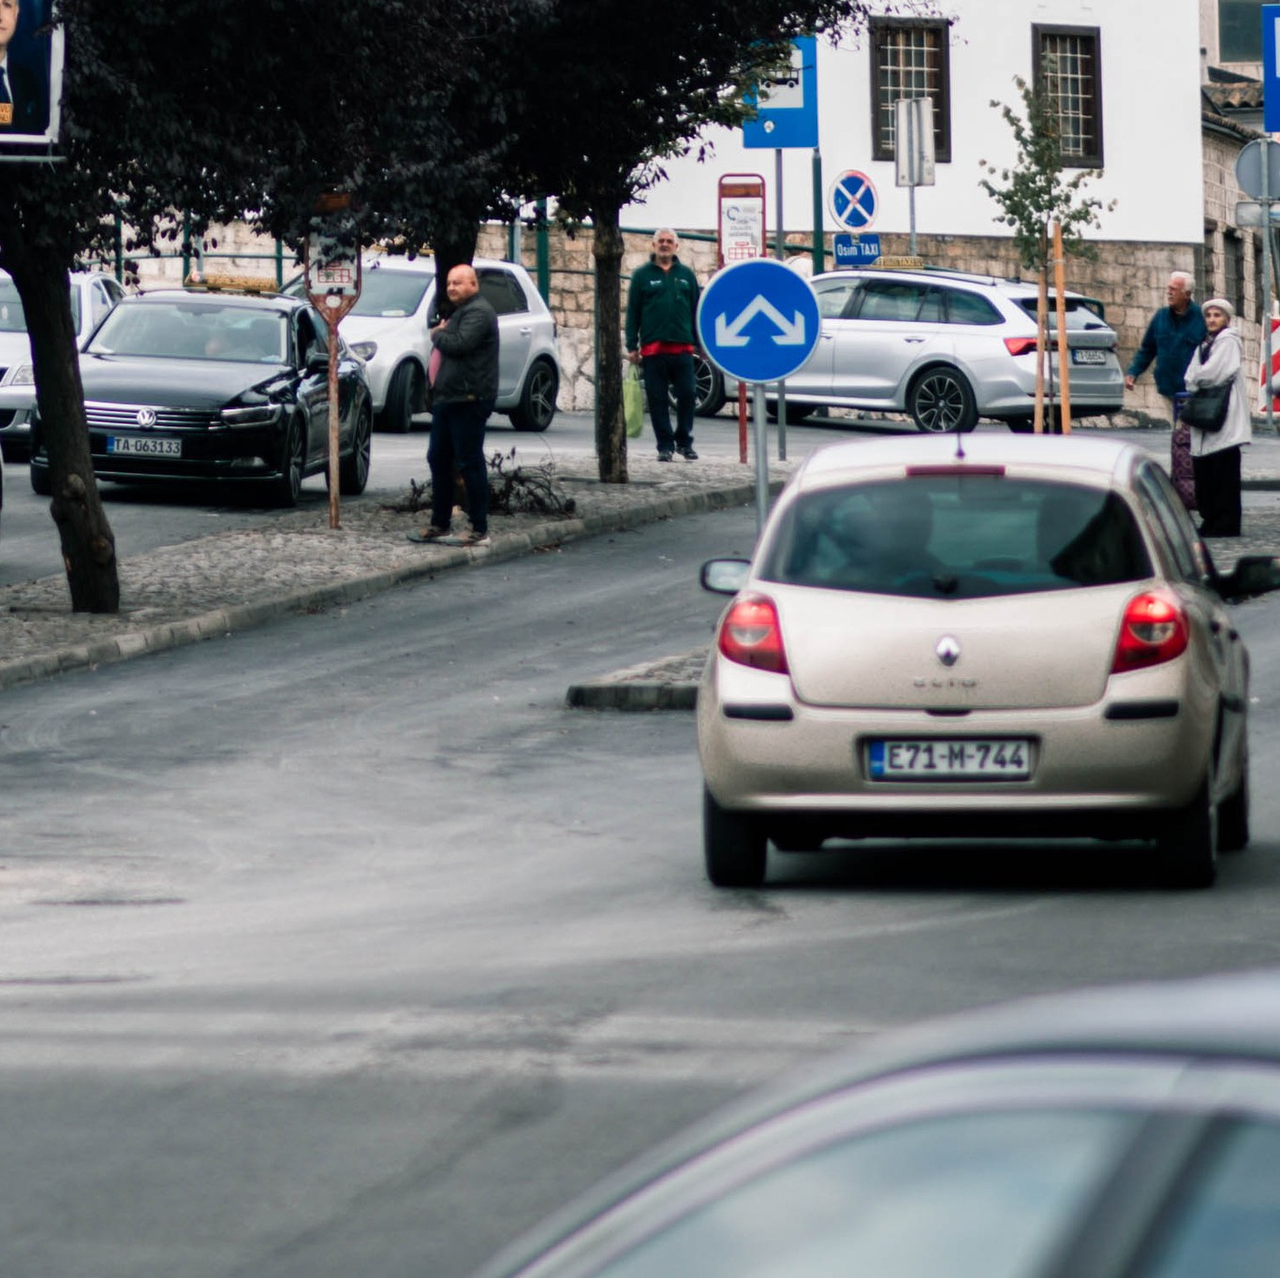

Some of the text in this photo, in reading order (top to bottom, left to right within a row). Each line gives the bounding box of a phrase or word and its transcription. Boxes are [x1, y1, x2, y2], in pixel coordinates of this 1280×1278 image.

[837, 243, 879, 256] Osim TAXI
[115, 438, 181, 454] TA-063133
[888, 744, 1024, 769] E71-M-744
